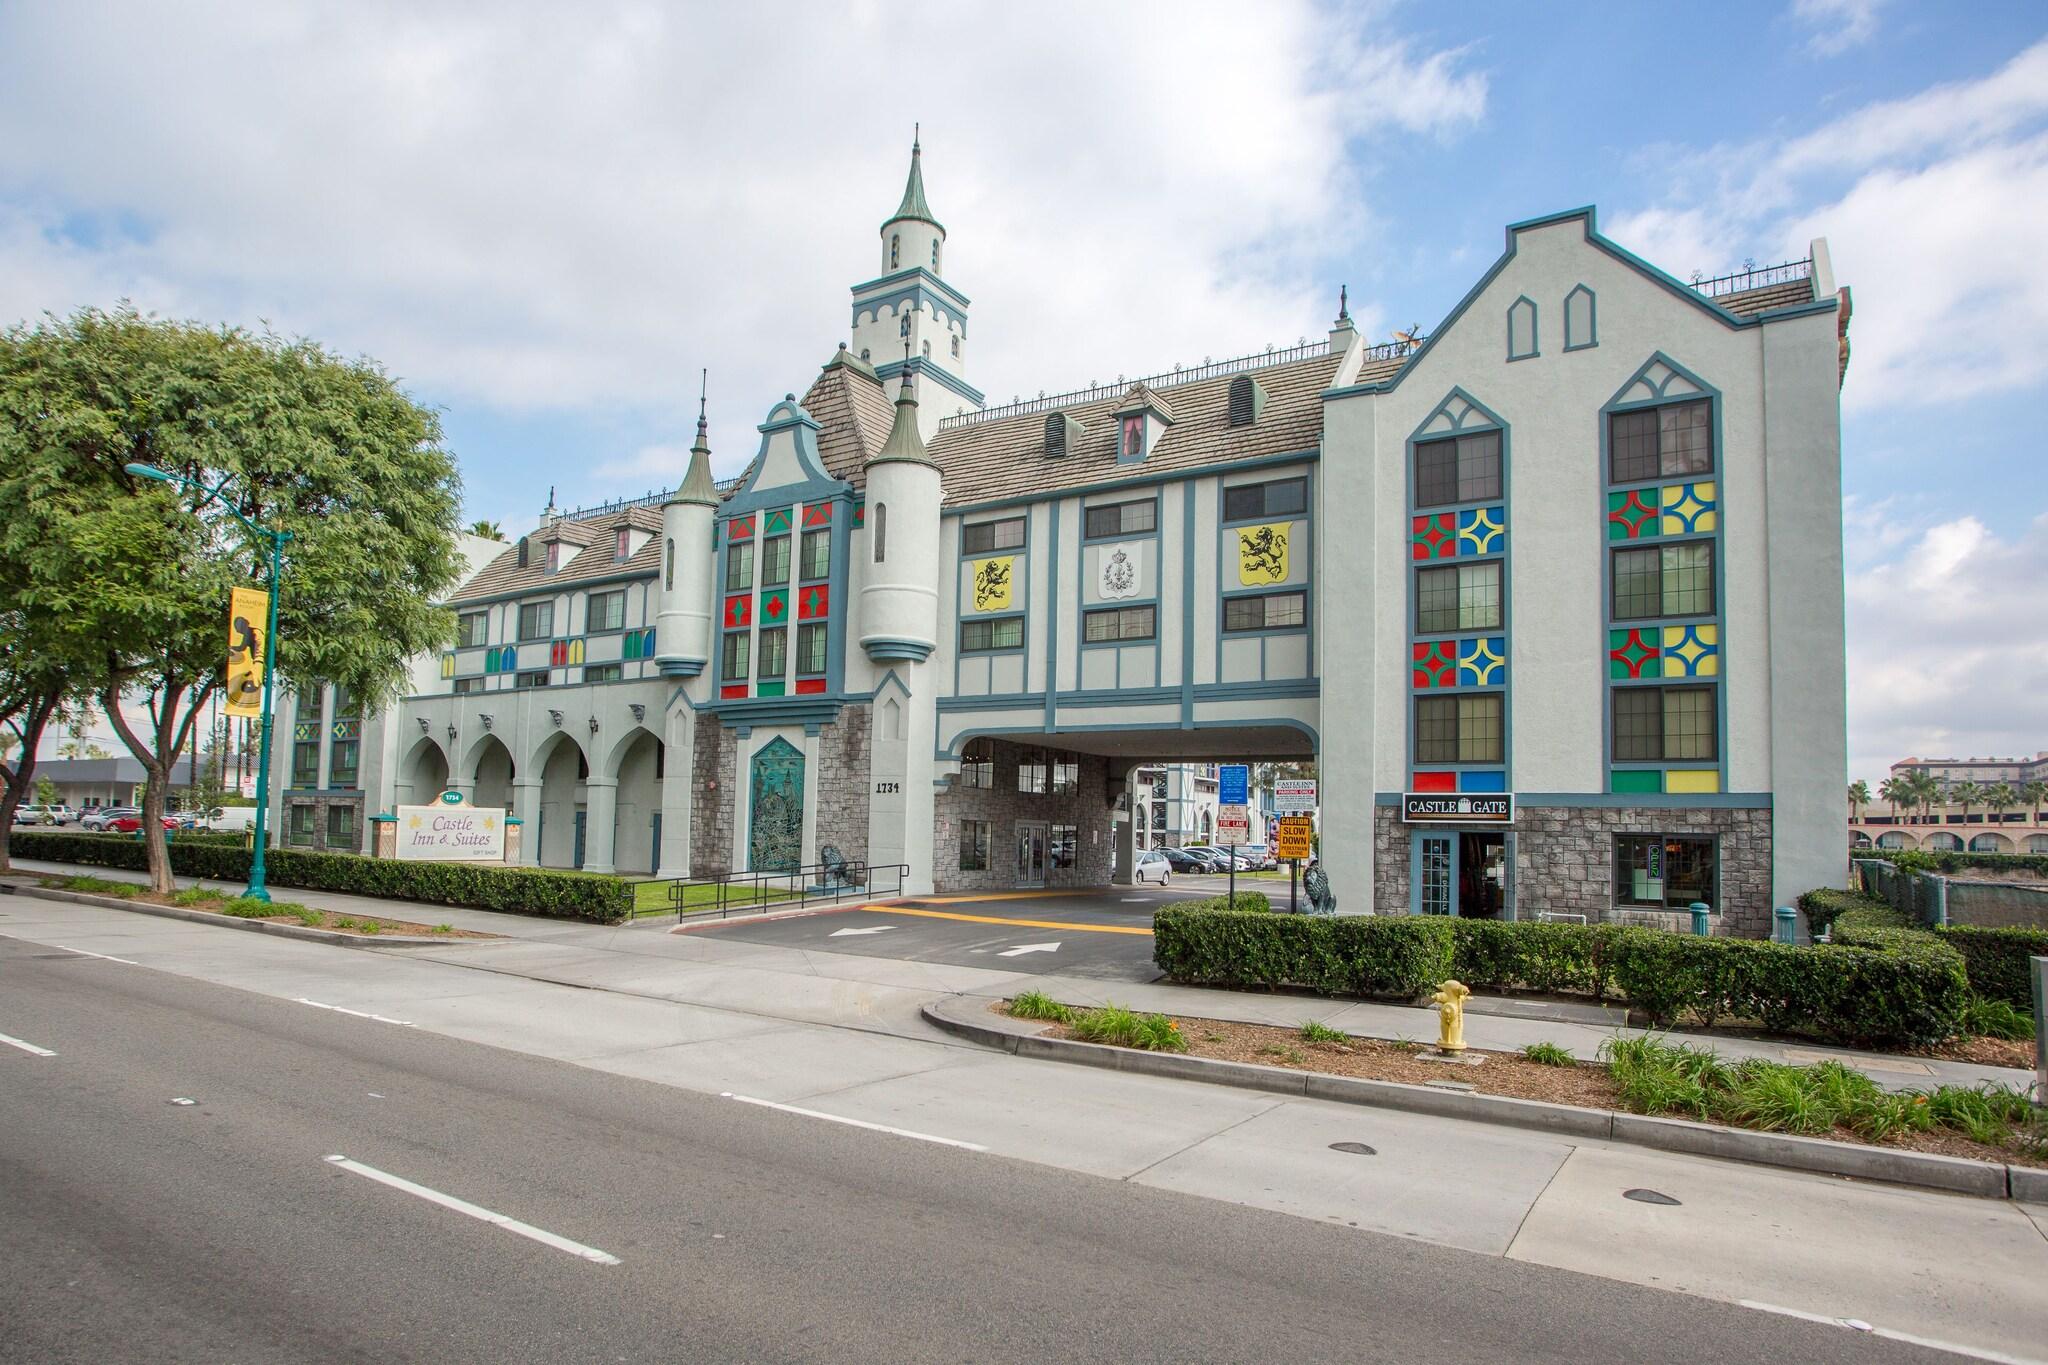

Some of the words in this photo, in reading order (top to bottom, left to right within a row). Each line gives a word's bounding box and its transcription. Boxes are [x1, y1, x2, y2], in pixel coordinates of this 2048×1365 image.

[876, 783, 899, 793] 1734
[1408, 801, 1456, 813] CASTLE
[1472, 801, 1507, 813] GATE
[432, 815, 473, 831] Castle
[1281, 817, 1309, 825] CAUTION
[1283, 826, 1306, 835] SLOW
[411, 831, 435, 846] Inn
[439, 833, 449, 845] &
[452, 832, 491, 847] Suites
[1282, 836, 1307, 845] DOWN
[1651, 846, 1660, 877] OPEN
